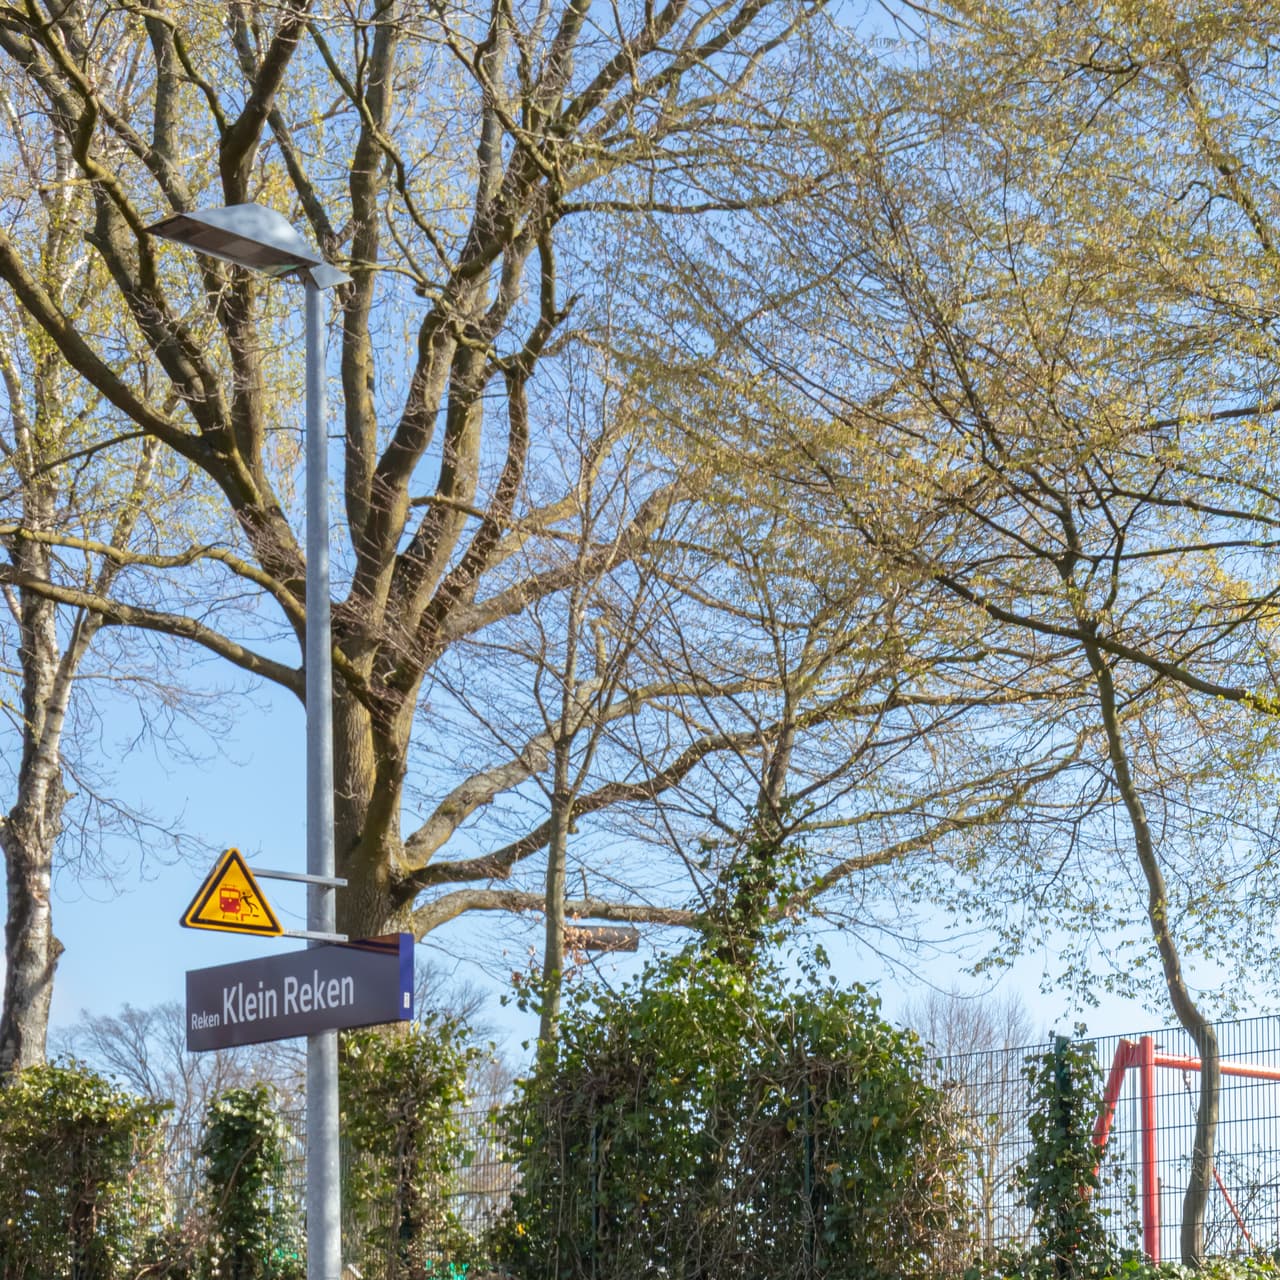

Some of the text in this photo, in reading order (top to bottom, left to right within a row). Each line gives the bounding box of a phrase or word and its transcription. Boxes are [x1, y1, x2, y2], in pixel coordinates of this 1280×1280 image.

[191, 969, 354, 1030] Reken Klein Reken
